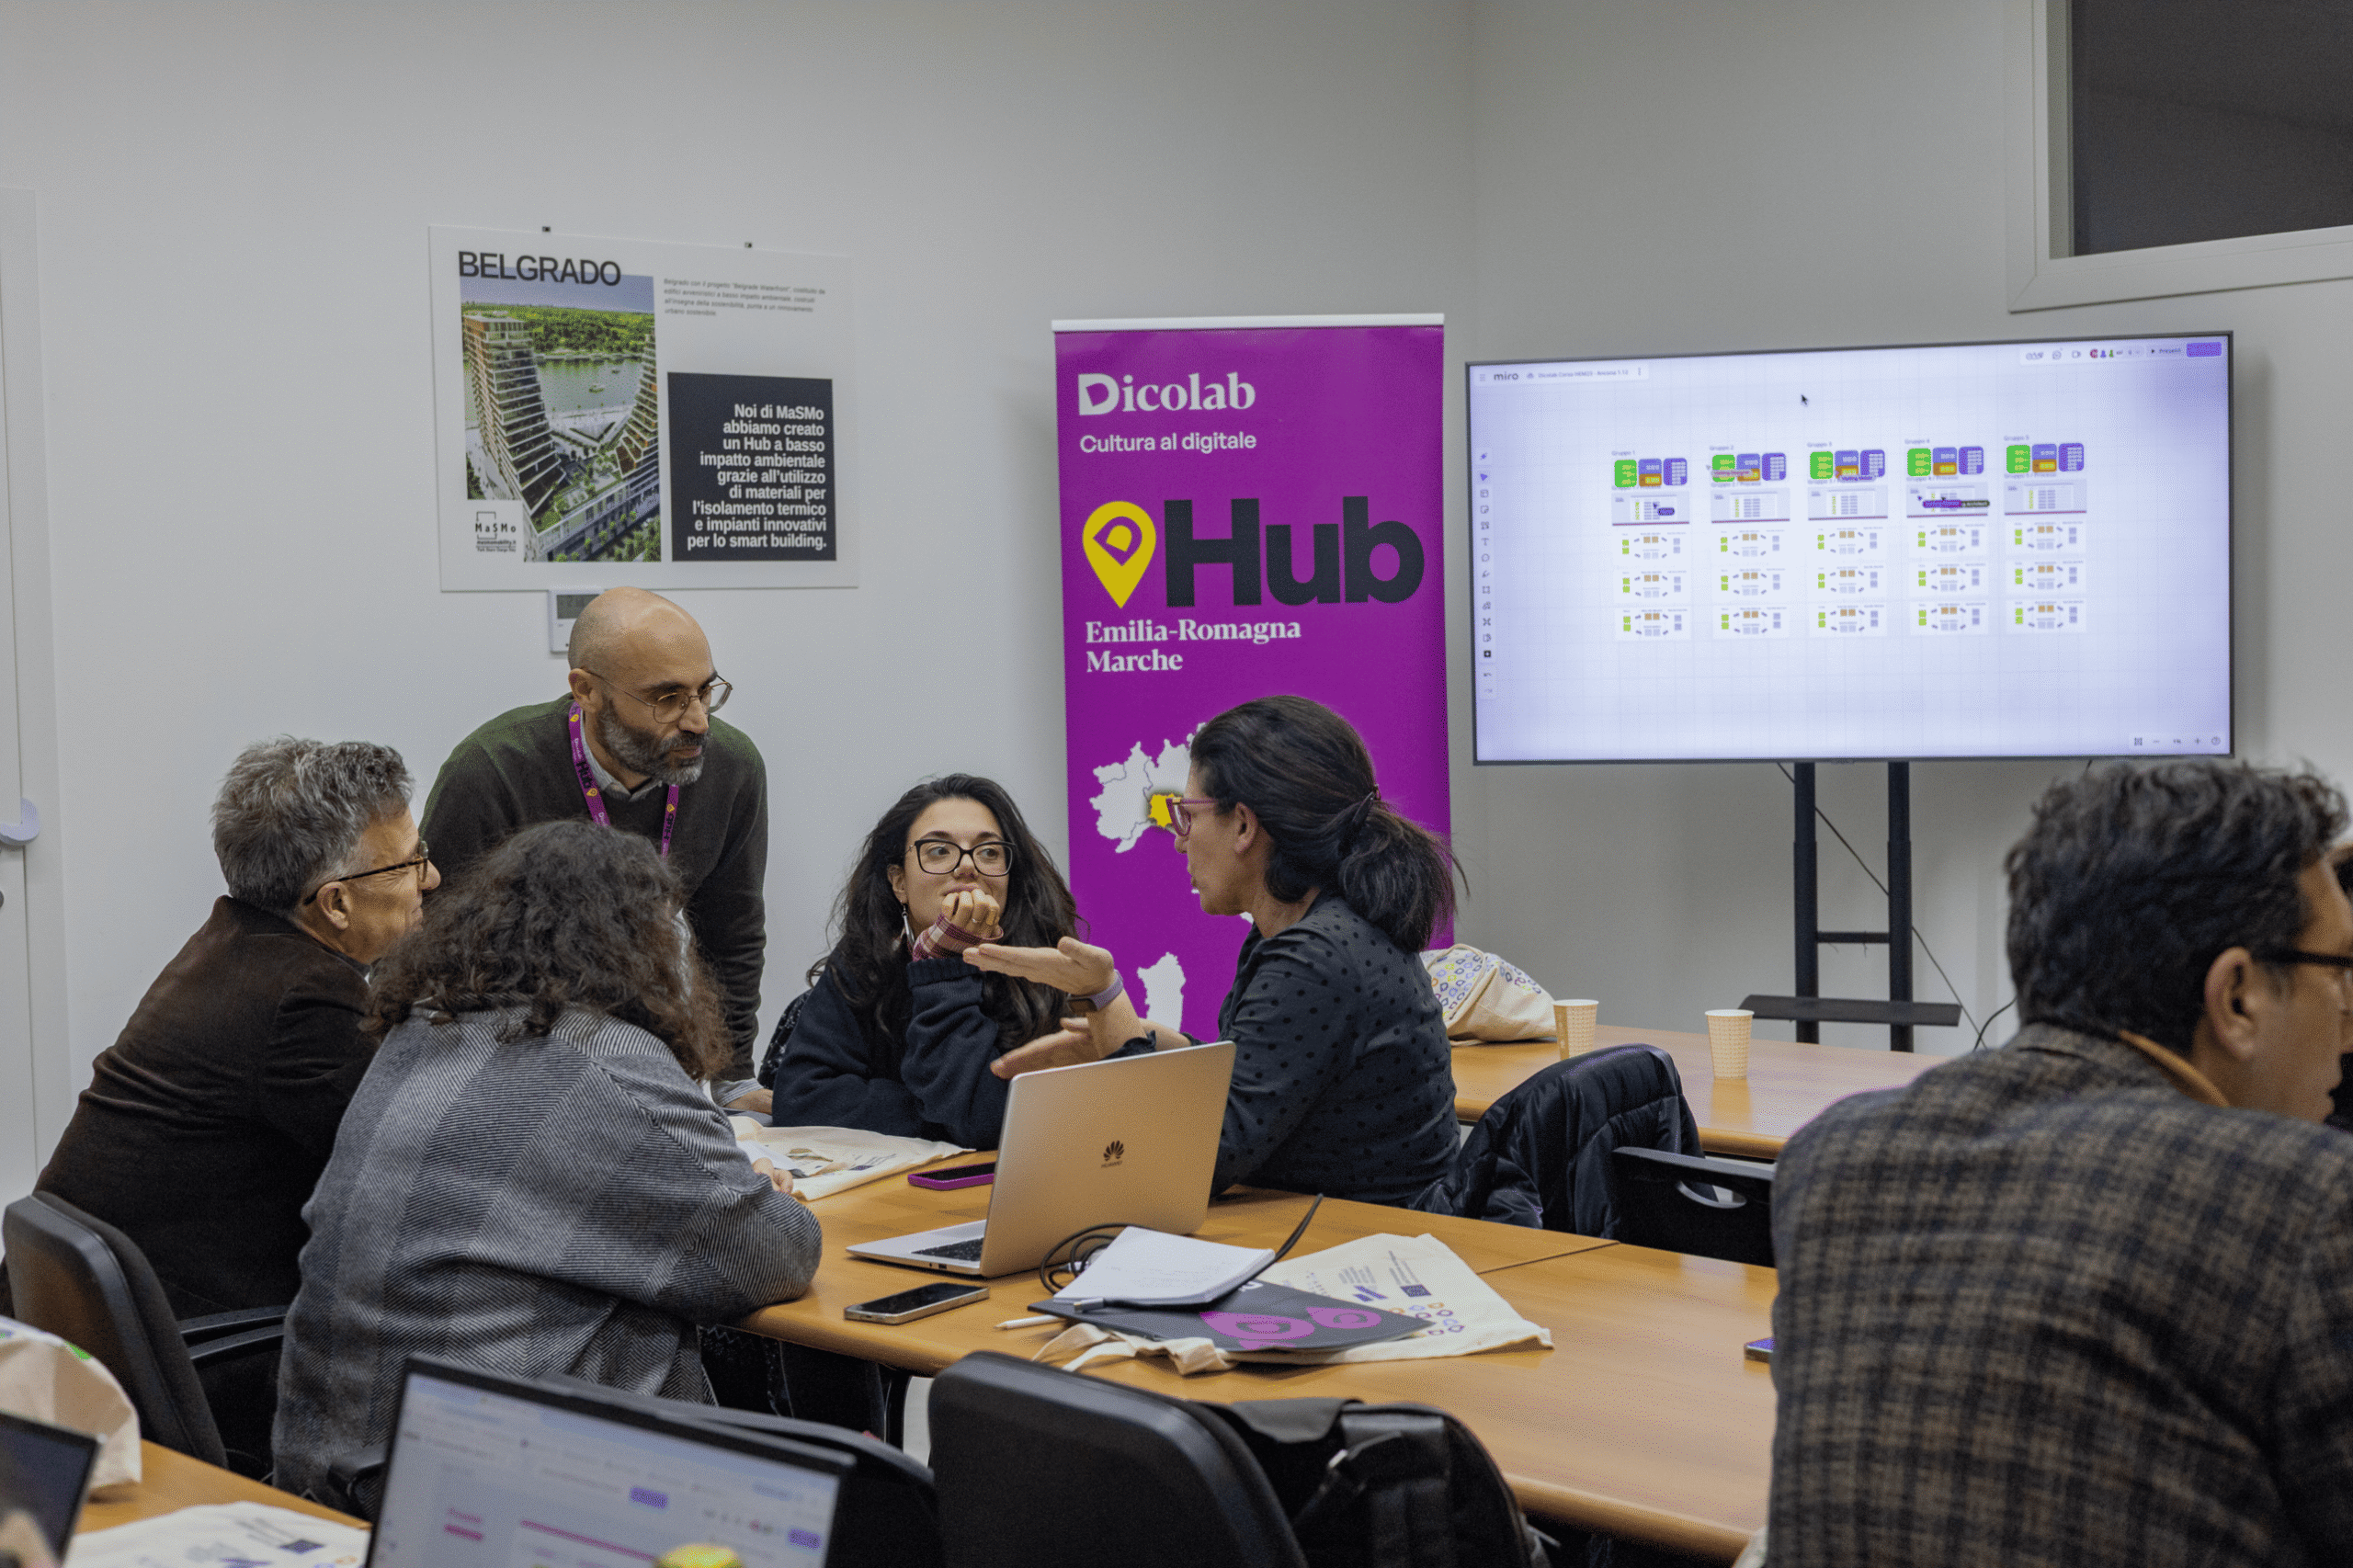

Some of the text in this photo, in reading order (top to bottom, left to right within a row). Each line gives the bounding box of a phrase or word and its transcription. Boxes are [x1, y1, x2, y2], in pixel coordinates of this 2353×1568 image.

[459, 251, 621, 287] BELGRADO
[1494, 371, 1518, 381] miro
[1078, 372, 1256, 415] Dicolab
[734, 403, 824, 420] Noi di MaSMo
[722, 419, 824, 436] abbiamo creato
[723, 437, 825, 452] un Hub a basso
[1079, 432, 1256, 454] Cultura al digitale
[699, 450, 825, 470] impatto ambientale
[717, 469, 826, 485] grazie all'utilizzo
[729, 484, 826, 503] di materiali per
[692, 500, 826, 516] l'isolamento termico
[475, 523, 517, 533] MaSMo
[694, 517, 827, 534] e impianti innovativi
[688, 533, 827, 551] per lo smart building.
[1164, 496, 1425, 608] Hub
[1086, 619, 1302, 644] Emilia-Romagna
[1086, 650, 1183, 673] Marche
[575, 761, 592, 789] Hub
[664, 812, 675, 840] Hub
